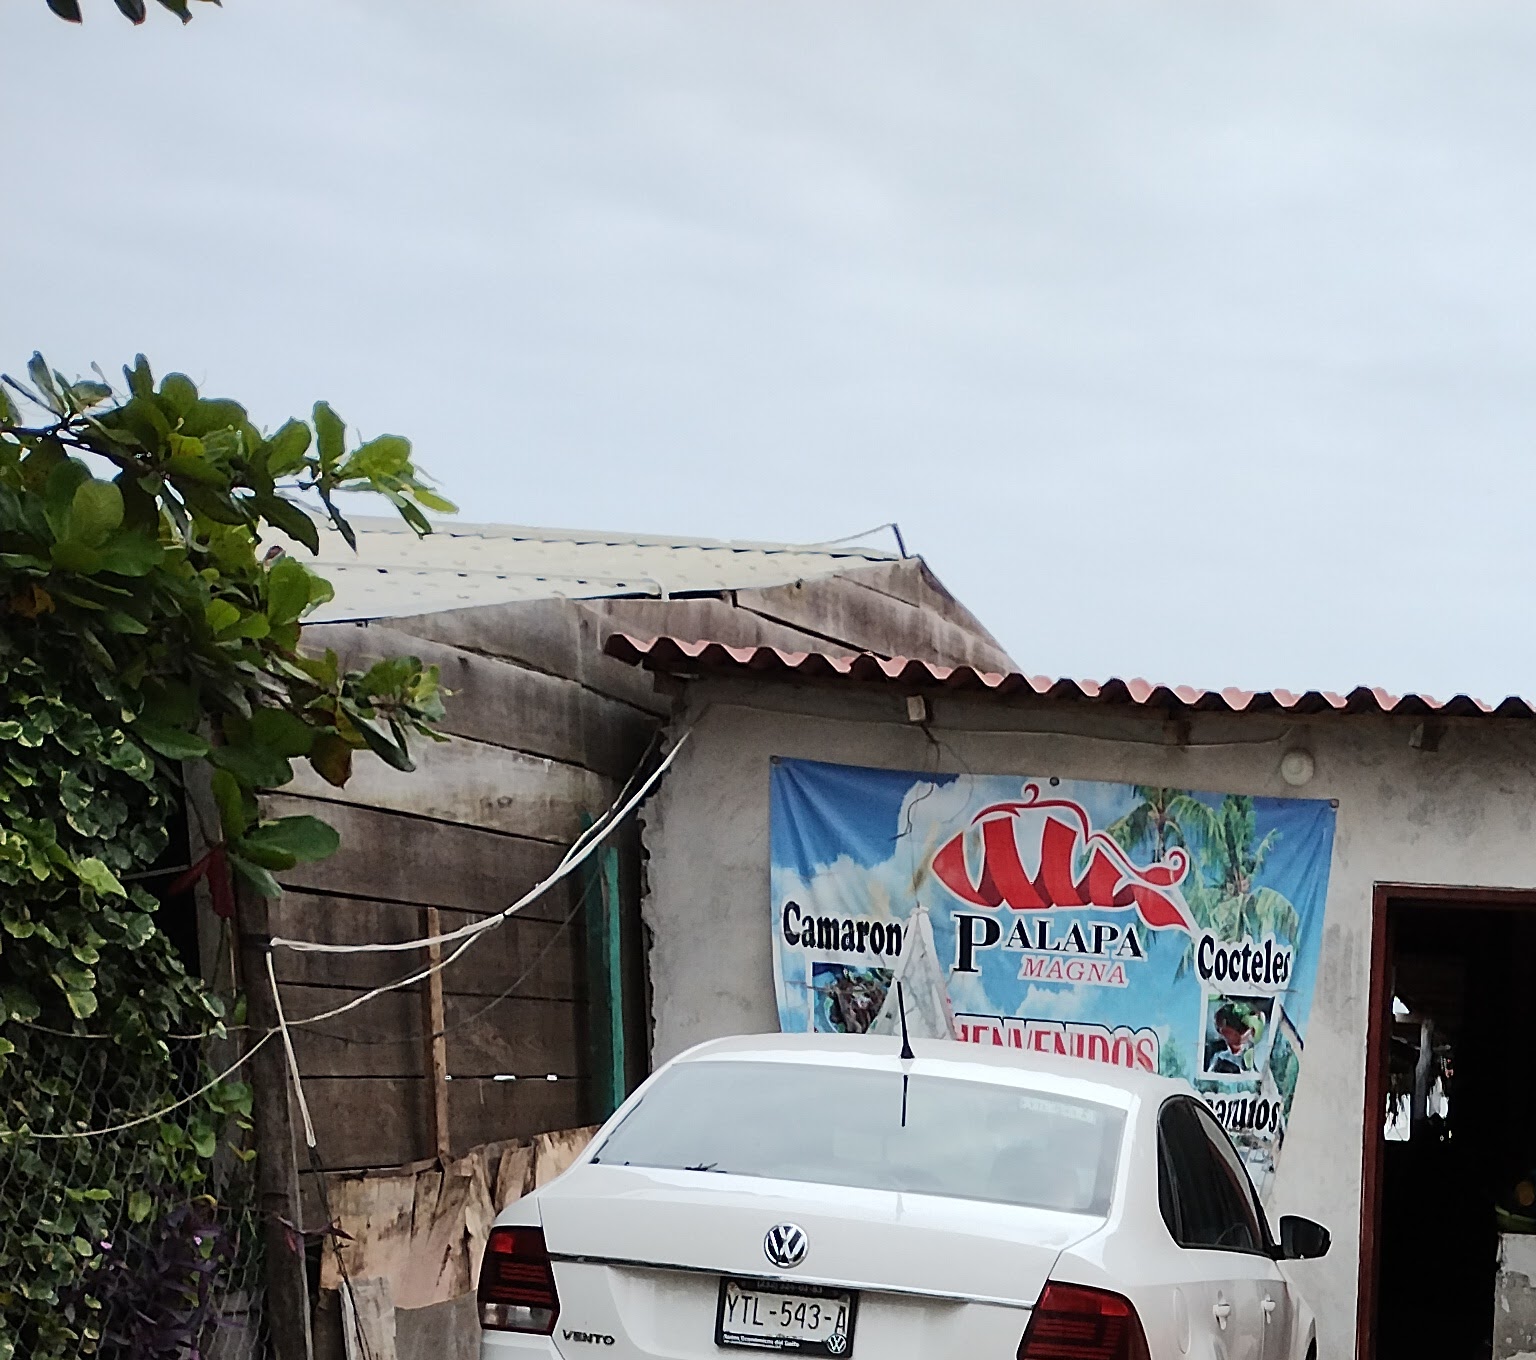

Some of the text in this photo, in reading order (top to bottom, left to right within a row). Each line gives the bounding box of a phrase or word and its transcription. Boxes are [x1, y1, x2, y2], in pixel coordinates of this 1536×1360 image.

[783, 901, 909, 957] Camaron
[953, 913, 1144, 973] PALAPA
[1022, 957, 1126, 985] MAGNA
[1198, 935, 1290, 984] Cocteles
[727, 1294, 847, 1334] YTL-543-A
[563, 1329, 616, 1346] VENTO
